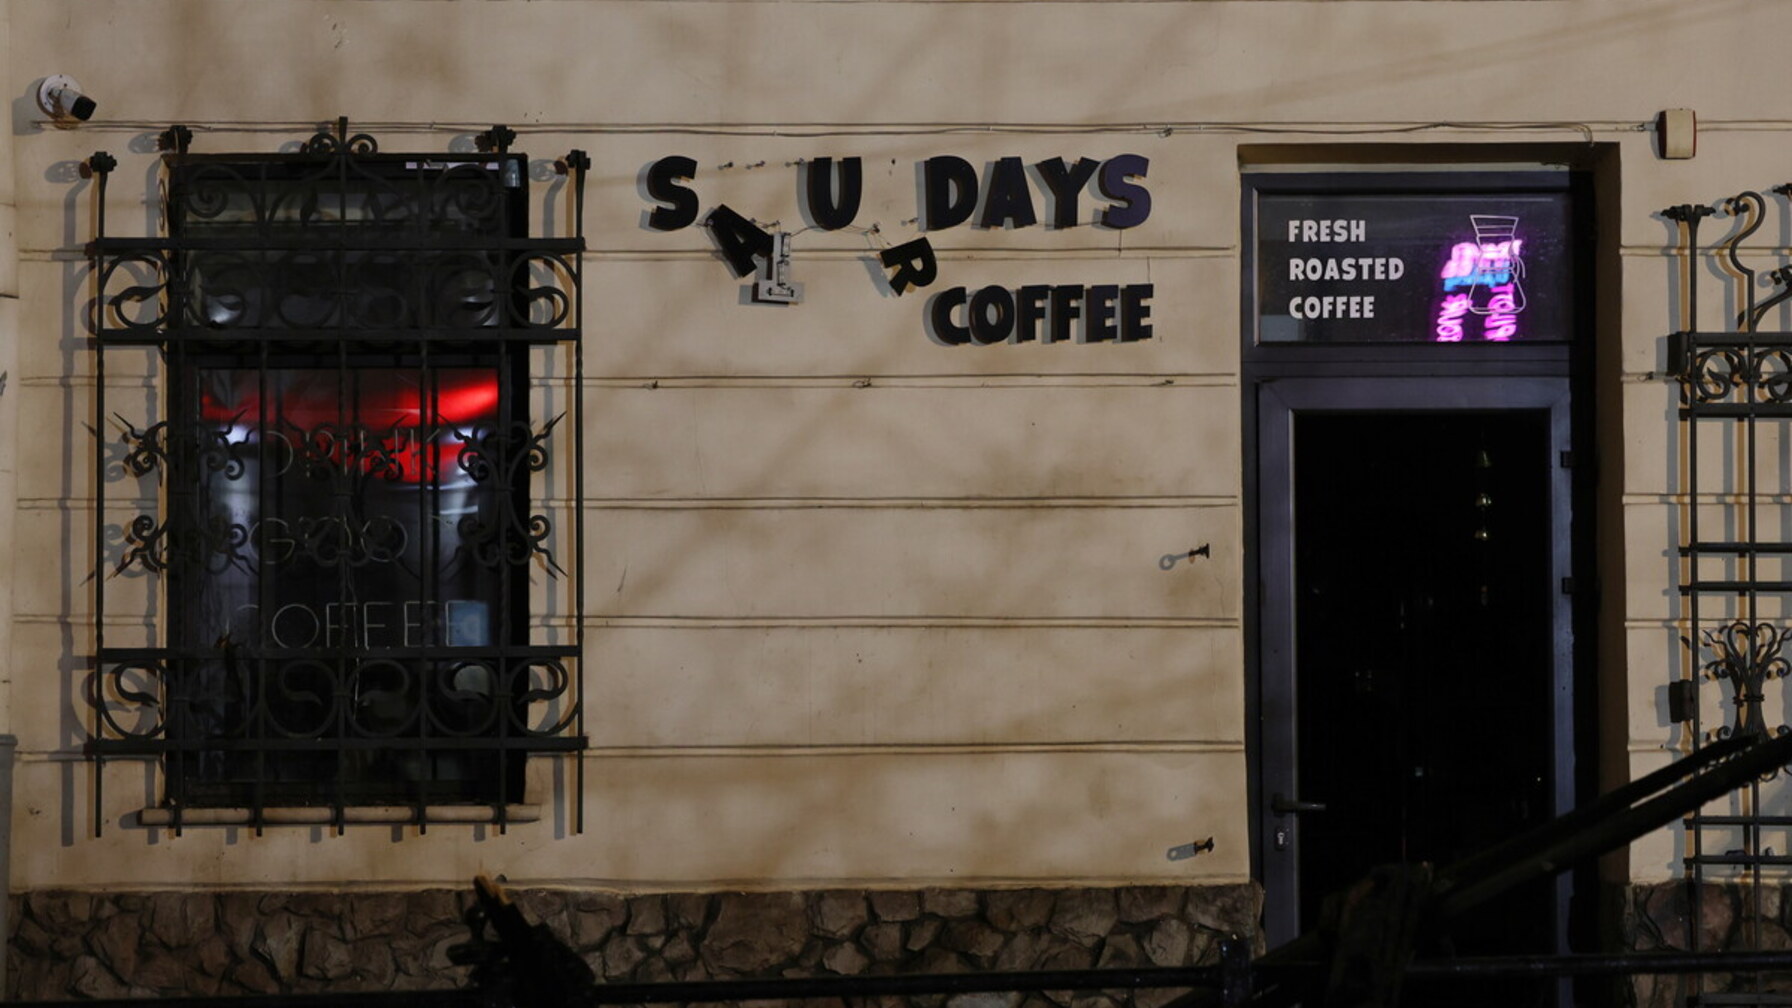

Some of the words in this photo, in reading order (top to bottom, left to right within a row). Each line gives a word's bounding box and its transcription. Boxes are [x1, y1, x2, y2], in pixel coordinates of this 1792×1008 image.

[1288, 219, 1366, 243] FRESH
[1289, 257, 1405, 281] ROASTED
[931, 284, 1154, 345] COFFEE
[1289, 295, 1375, 319] COFFEE
[248, 516, 458, 564] GOO
[230, 600, 482, 648] OFFEE
